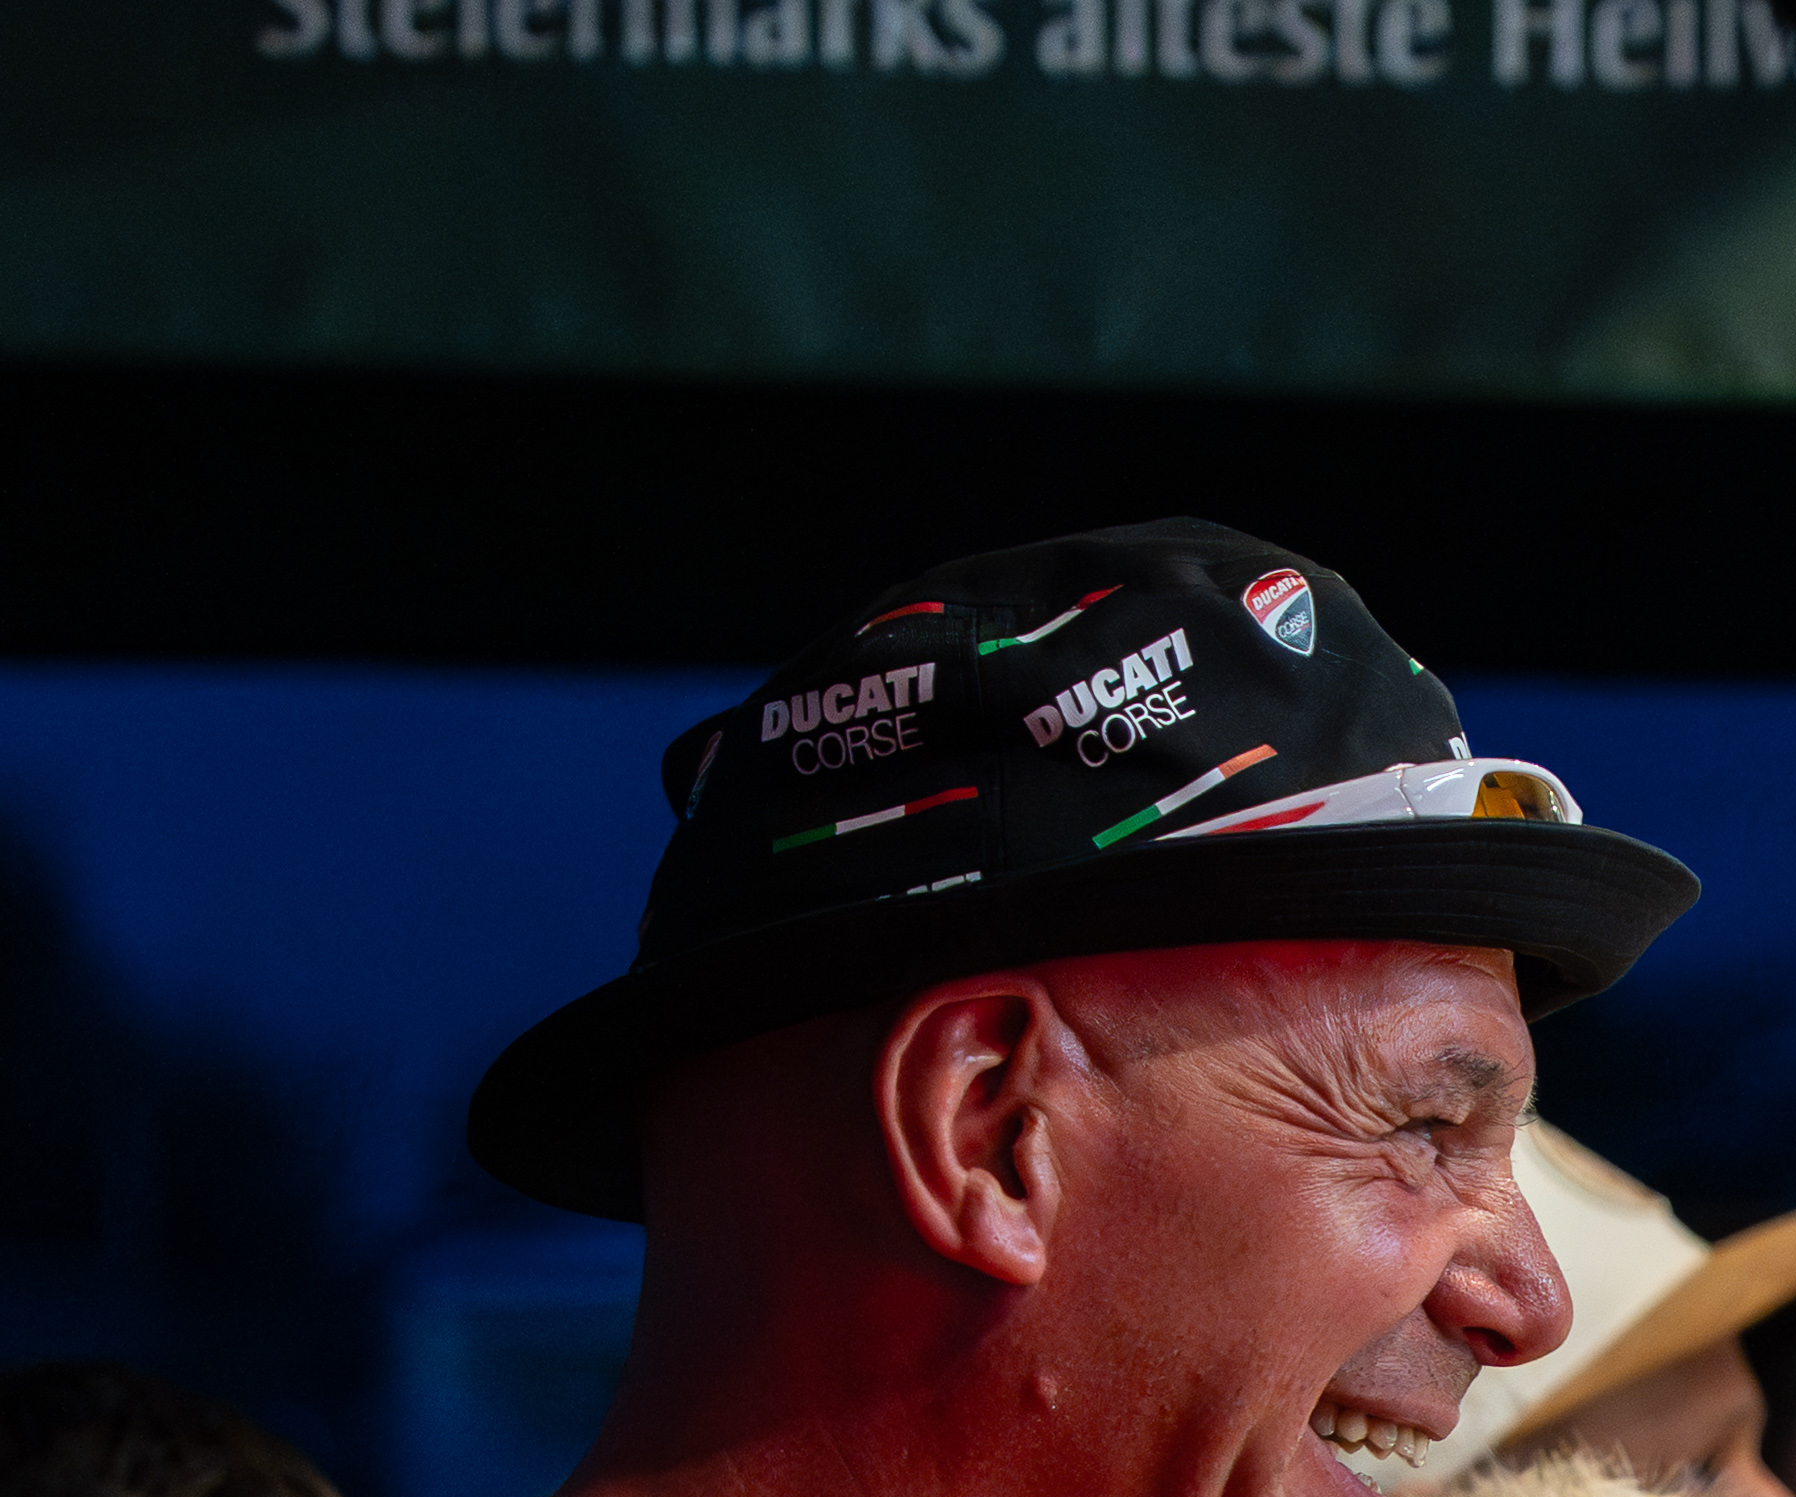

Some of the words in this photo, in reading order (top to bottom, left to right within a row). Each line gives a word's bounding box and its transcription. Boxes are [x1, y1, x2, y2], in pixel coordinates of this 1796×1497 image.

[1252, 576, 1299, 611] DUCATI
[760, 662, 936, 743] DUCATI
[1023, 631, 1194, 748] DUCATI
[1077, 680, 1196, 768] CORSE
[792, 712, 924, 775] CORSE
